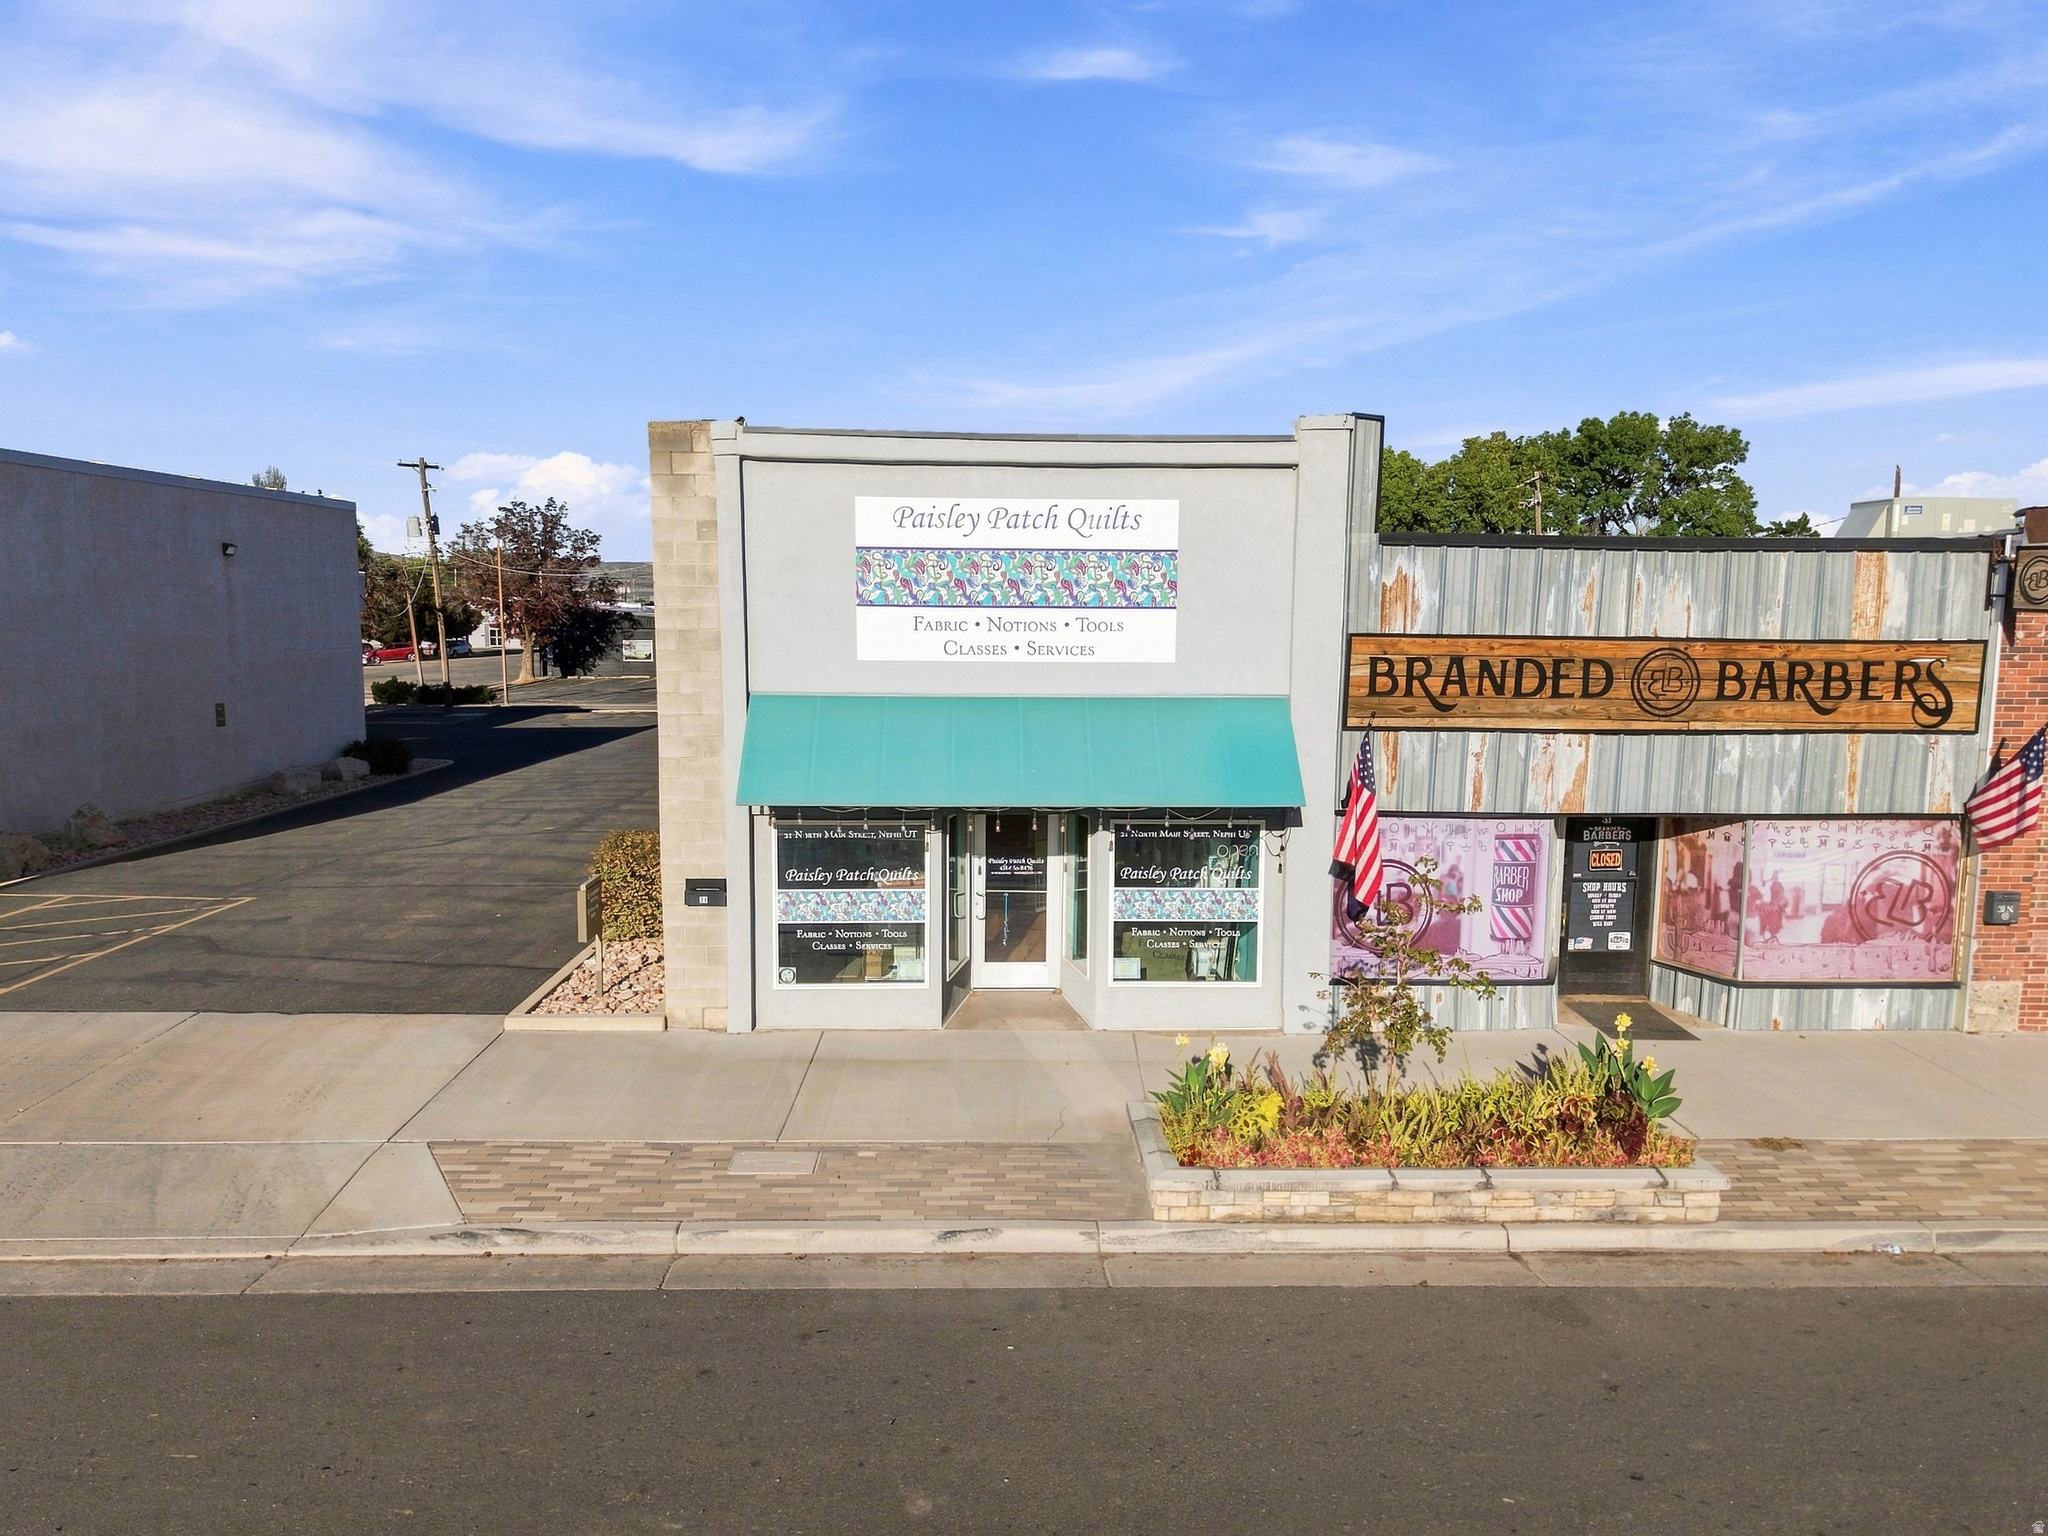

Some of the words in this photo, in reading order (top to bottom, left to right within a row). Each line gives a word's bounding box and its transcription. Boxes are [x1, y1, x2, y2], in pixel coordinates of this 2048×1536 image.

[892, 503, 980, 537] Paisley
[987, 504, 1059, 530] Patch
[1067, 505, 1143, 538] Quilts
[913, 616, 968, 632] FABRIC
[987, 616, 1057, 632] NOTIONS
[1075, 617, 1124, 632] TOOLS
[943, 640, 1007, 656] CLASSES
[1027, 640, 1095, 657] SERVICES
[1366, 656, 1614, 712] BRANDED
[1714, 658, 1953, 728] BARBERS
[824, 830, 846, 838] MAIN
[904, 830, 918, 838] UT
[1130, 830, 1157, 838] NORTH
[1160, 830, 1180, 838] MAIN
[1213, 830, 1236, 838] NEPHI
[1583, 830, 1632, 841] BARBERS
[1217, 844, 1259, 860] open
[1591, 852, 1621, 867] CLOSED
[785, 867, 833, 885] Paisley
[836, 867, 875, 881] Patch
[878, 867, 919, 885] Quilts
[1120, 866, 1167, 884] Paisley
[1169, 865, 1208, 880] Patch
[1211, 866, 1253, 883] Quilts
[1493, 866, 1530, 891] BARBER
[1495, 887, 1524, 902] SHOP
[1582, 882, 1601, 892] SHOP
[1603, 882, 1627, 892] HOURS
[796, 929, 826, 938] FABRIC
[835, 929, 872, 938] NOTIONS
[881, 929, 907, 938] TOOLS
[1131, 927, 1160, 936] FABRIC
[1169, 927, 1206, 936] NOTIONS
[1214, 927, 1241, 937] TOOLS
[812, 941, 846, 950] CLASSES
[855, 941, 892, 950] SERVICES
[1146, 940, 1180, 948] CLASSES
